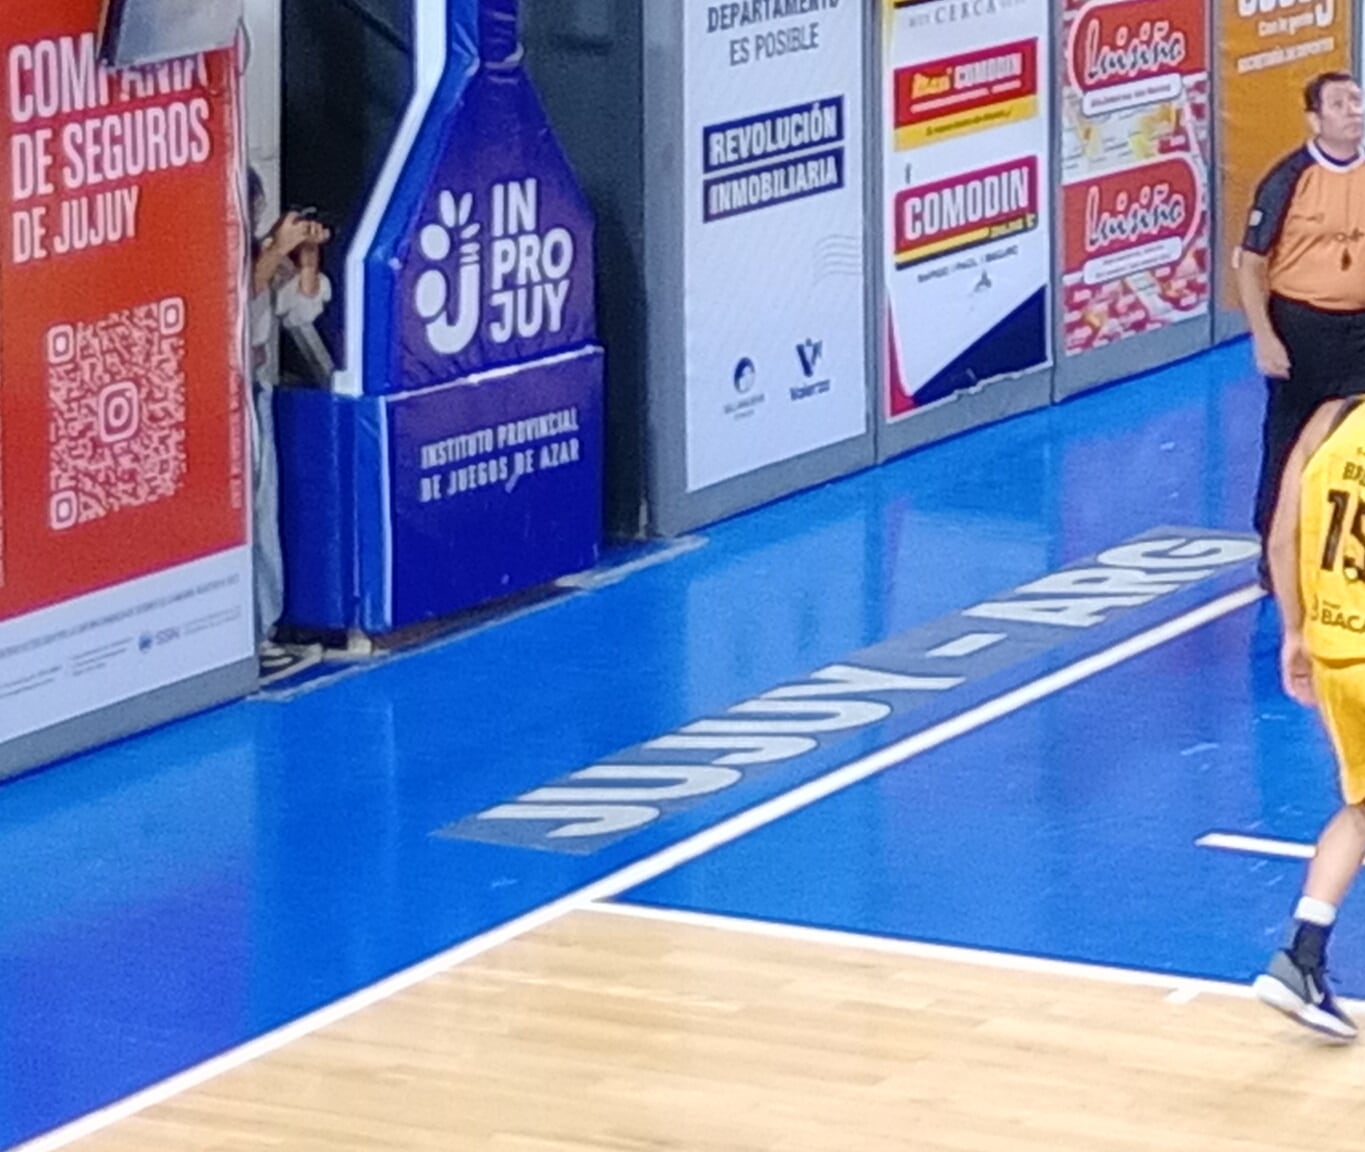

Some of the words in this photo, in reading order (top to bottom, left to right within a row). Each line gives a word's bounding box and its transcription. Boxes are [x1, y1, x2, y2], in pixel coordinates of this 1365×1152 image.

[729, 36, 750, 66] ES
[755, 22, 820, 60] POSIBLE
[12, 129, 53, 201] DE
[63, 97, 210, 191] SEGUROS
[709, 102, 838, 166] REVOLUCIÓN
[492, 178, 537, 235] IN
[709, 155, 839, 215] INMOBILIARIA
[905, 166, 1029, 240] COMODIN
[13, 208, 48, 265] DE
[53, 186, 140, 257] JUJUY
[491, 227, 573, 287] PRO
[488, 279, 569, 344] JUY
[420, 428, 494, 469] INSTITUTO
[497, 406, 579, 449] PROVINCIAL
[420, 474, 442, 502] DE
[447, 456, 508, 496] JUEGOS
[513, 449, 535, 476] DE
[540, 438, 580, 469] AZAR
[474, 664, 966, 838] JUJUY
[963, 536, 1262, 627] ARG
